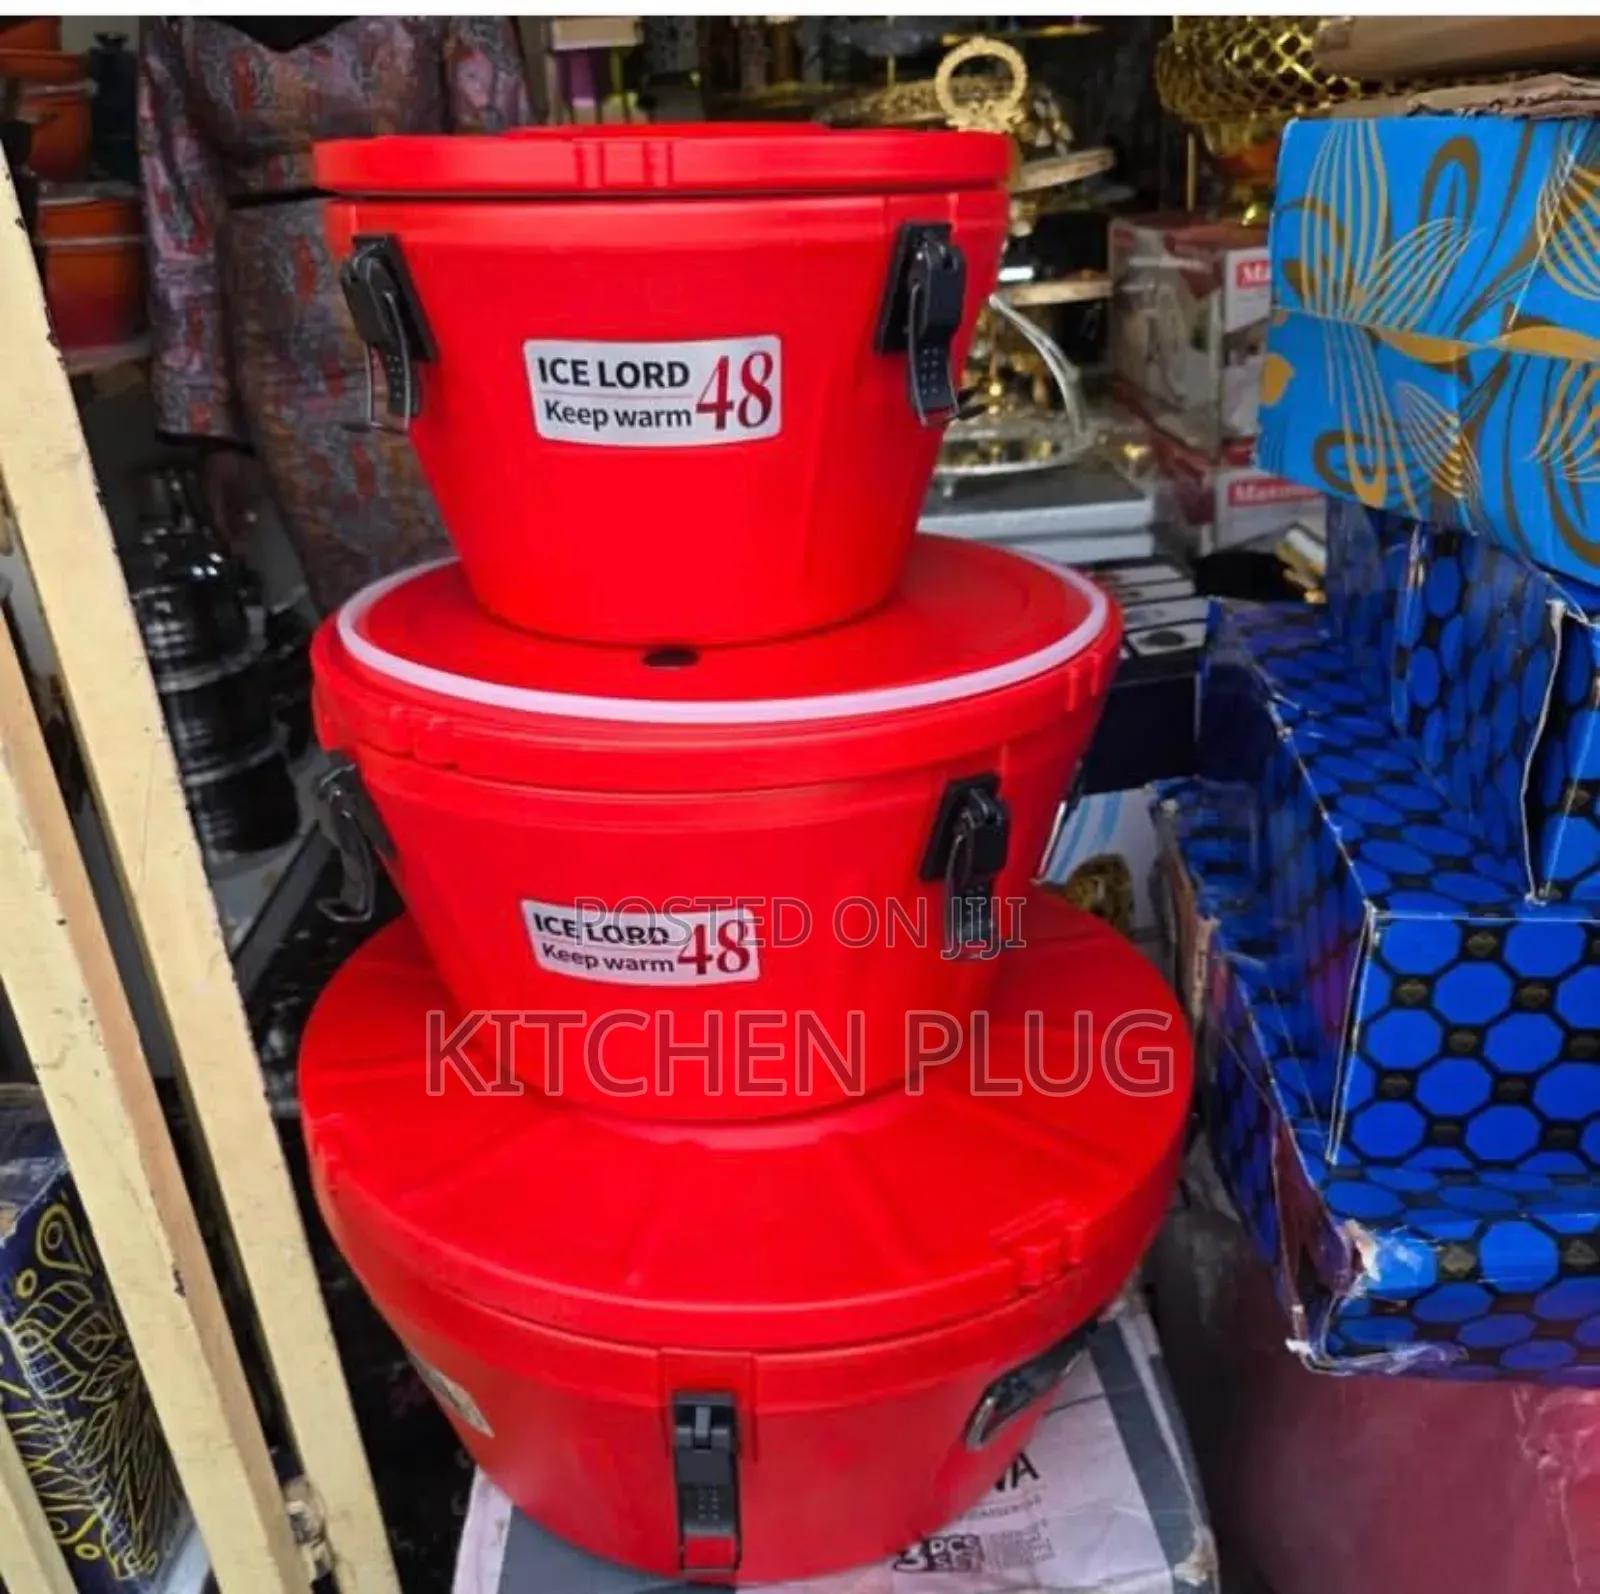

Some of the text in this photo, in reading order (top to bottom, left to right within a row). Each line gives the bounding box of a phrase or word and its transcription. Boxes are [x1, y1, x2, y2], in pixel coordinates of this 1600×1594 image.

[537, 356, 690, 389] ICE LORD
[696, 350, 774, 431] 48
[544, 398, 692, 432] Keep warm
[533, 912, 670, 947] ICE LORD
[541, 941, 675, 973] Keep warm
[677, 919, 751, 976] 48
